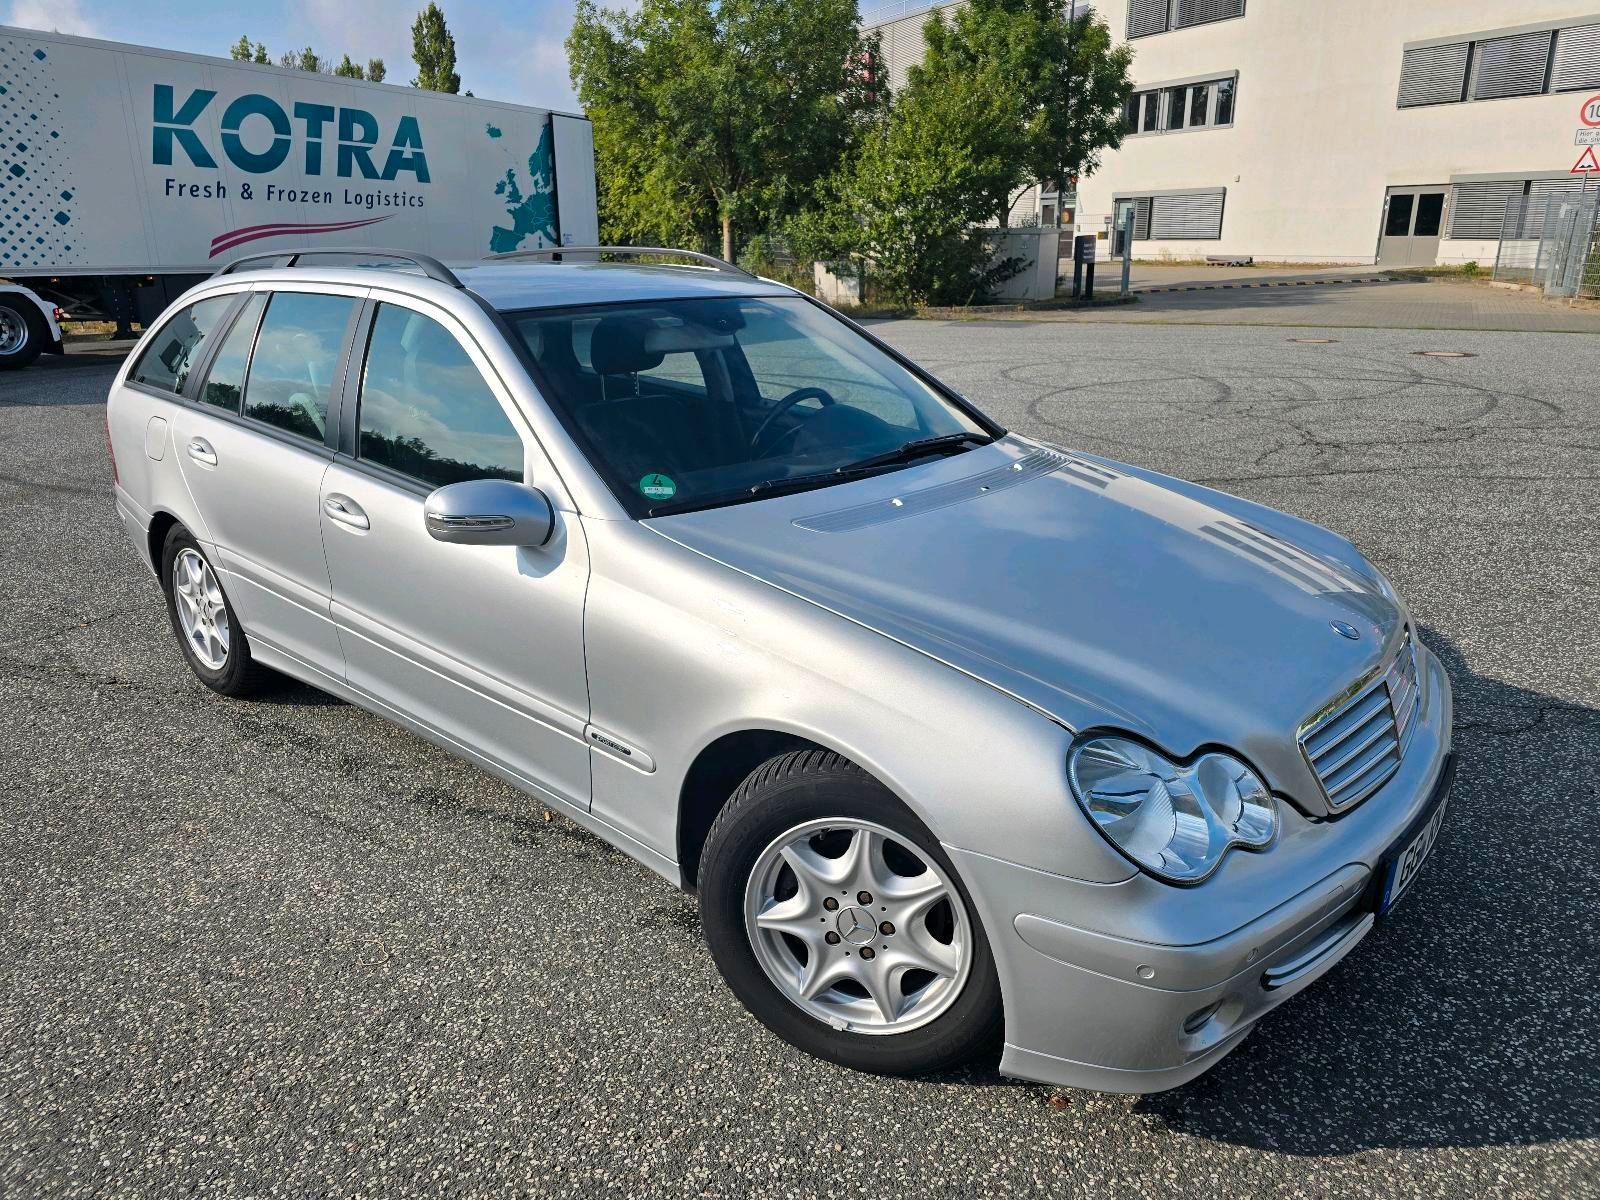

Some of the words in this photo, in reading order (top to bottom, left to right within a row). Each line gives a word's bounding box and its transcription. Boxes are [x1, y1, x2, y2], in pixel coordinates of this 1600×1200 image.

[153, 84, 431, 183] KOTRA
[165, 179, 227, 199] Fresh
[240, 183, 254, 201] &
[267, 184, 333, 204] Frozen
[344, 189, 425, 210] Logistics
[652, 475, 663, 487] 4
